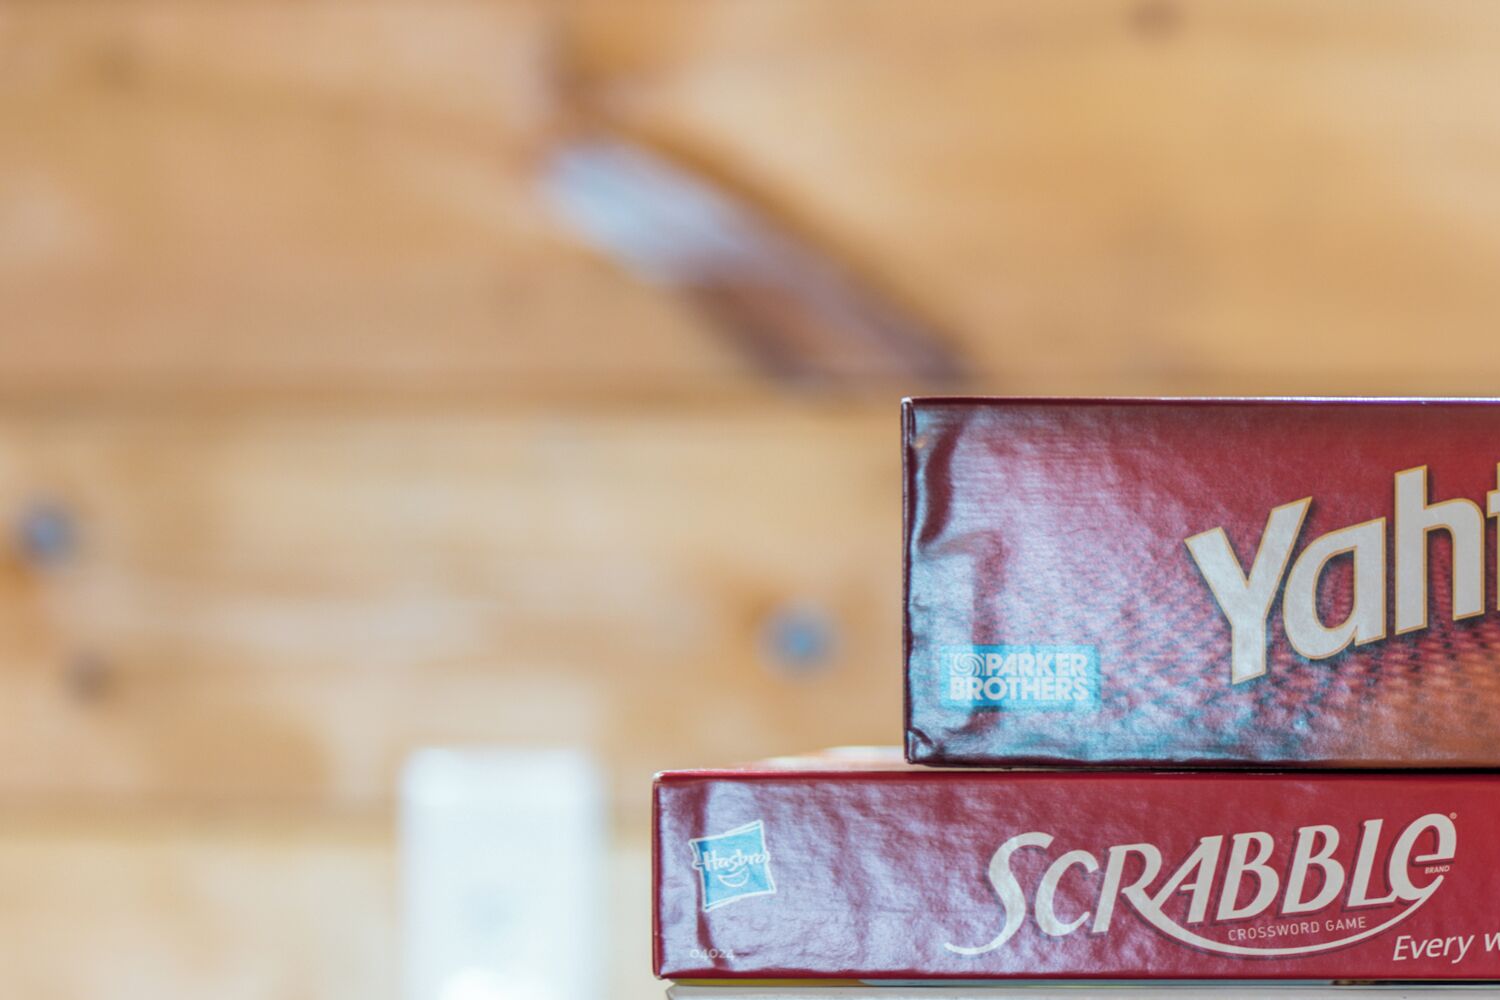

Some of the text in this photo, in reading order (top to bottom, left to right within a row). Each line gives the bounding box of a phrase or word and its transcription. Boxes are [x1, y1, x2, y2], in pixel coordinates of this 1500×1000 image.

[986, 653, 1088, 677] PARKER
[949, 677, 1089, 701] BROTHERS
[1425, 865, 1450, 874] BRAND
[1228, 917, 1367, 941] CROSSWORD GAME
[1393, 933, 1474, 963] Every
